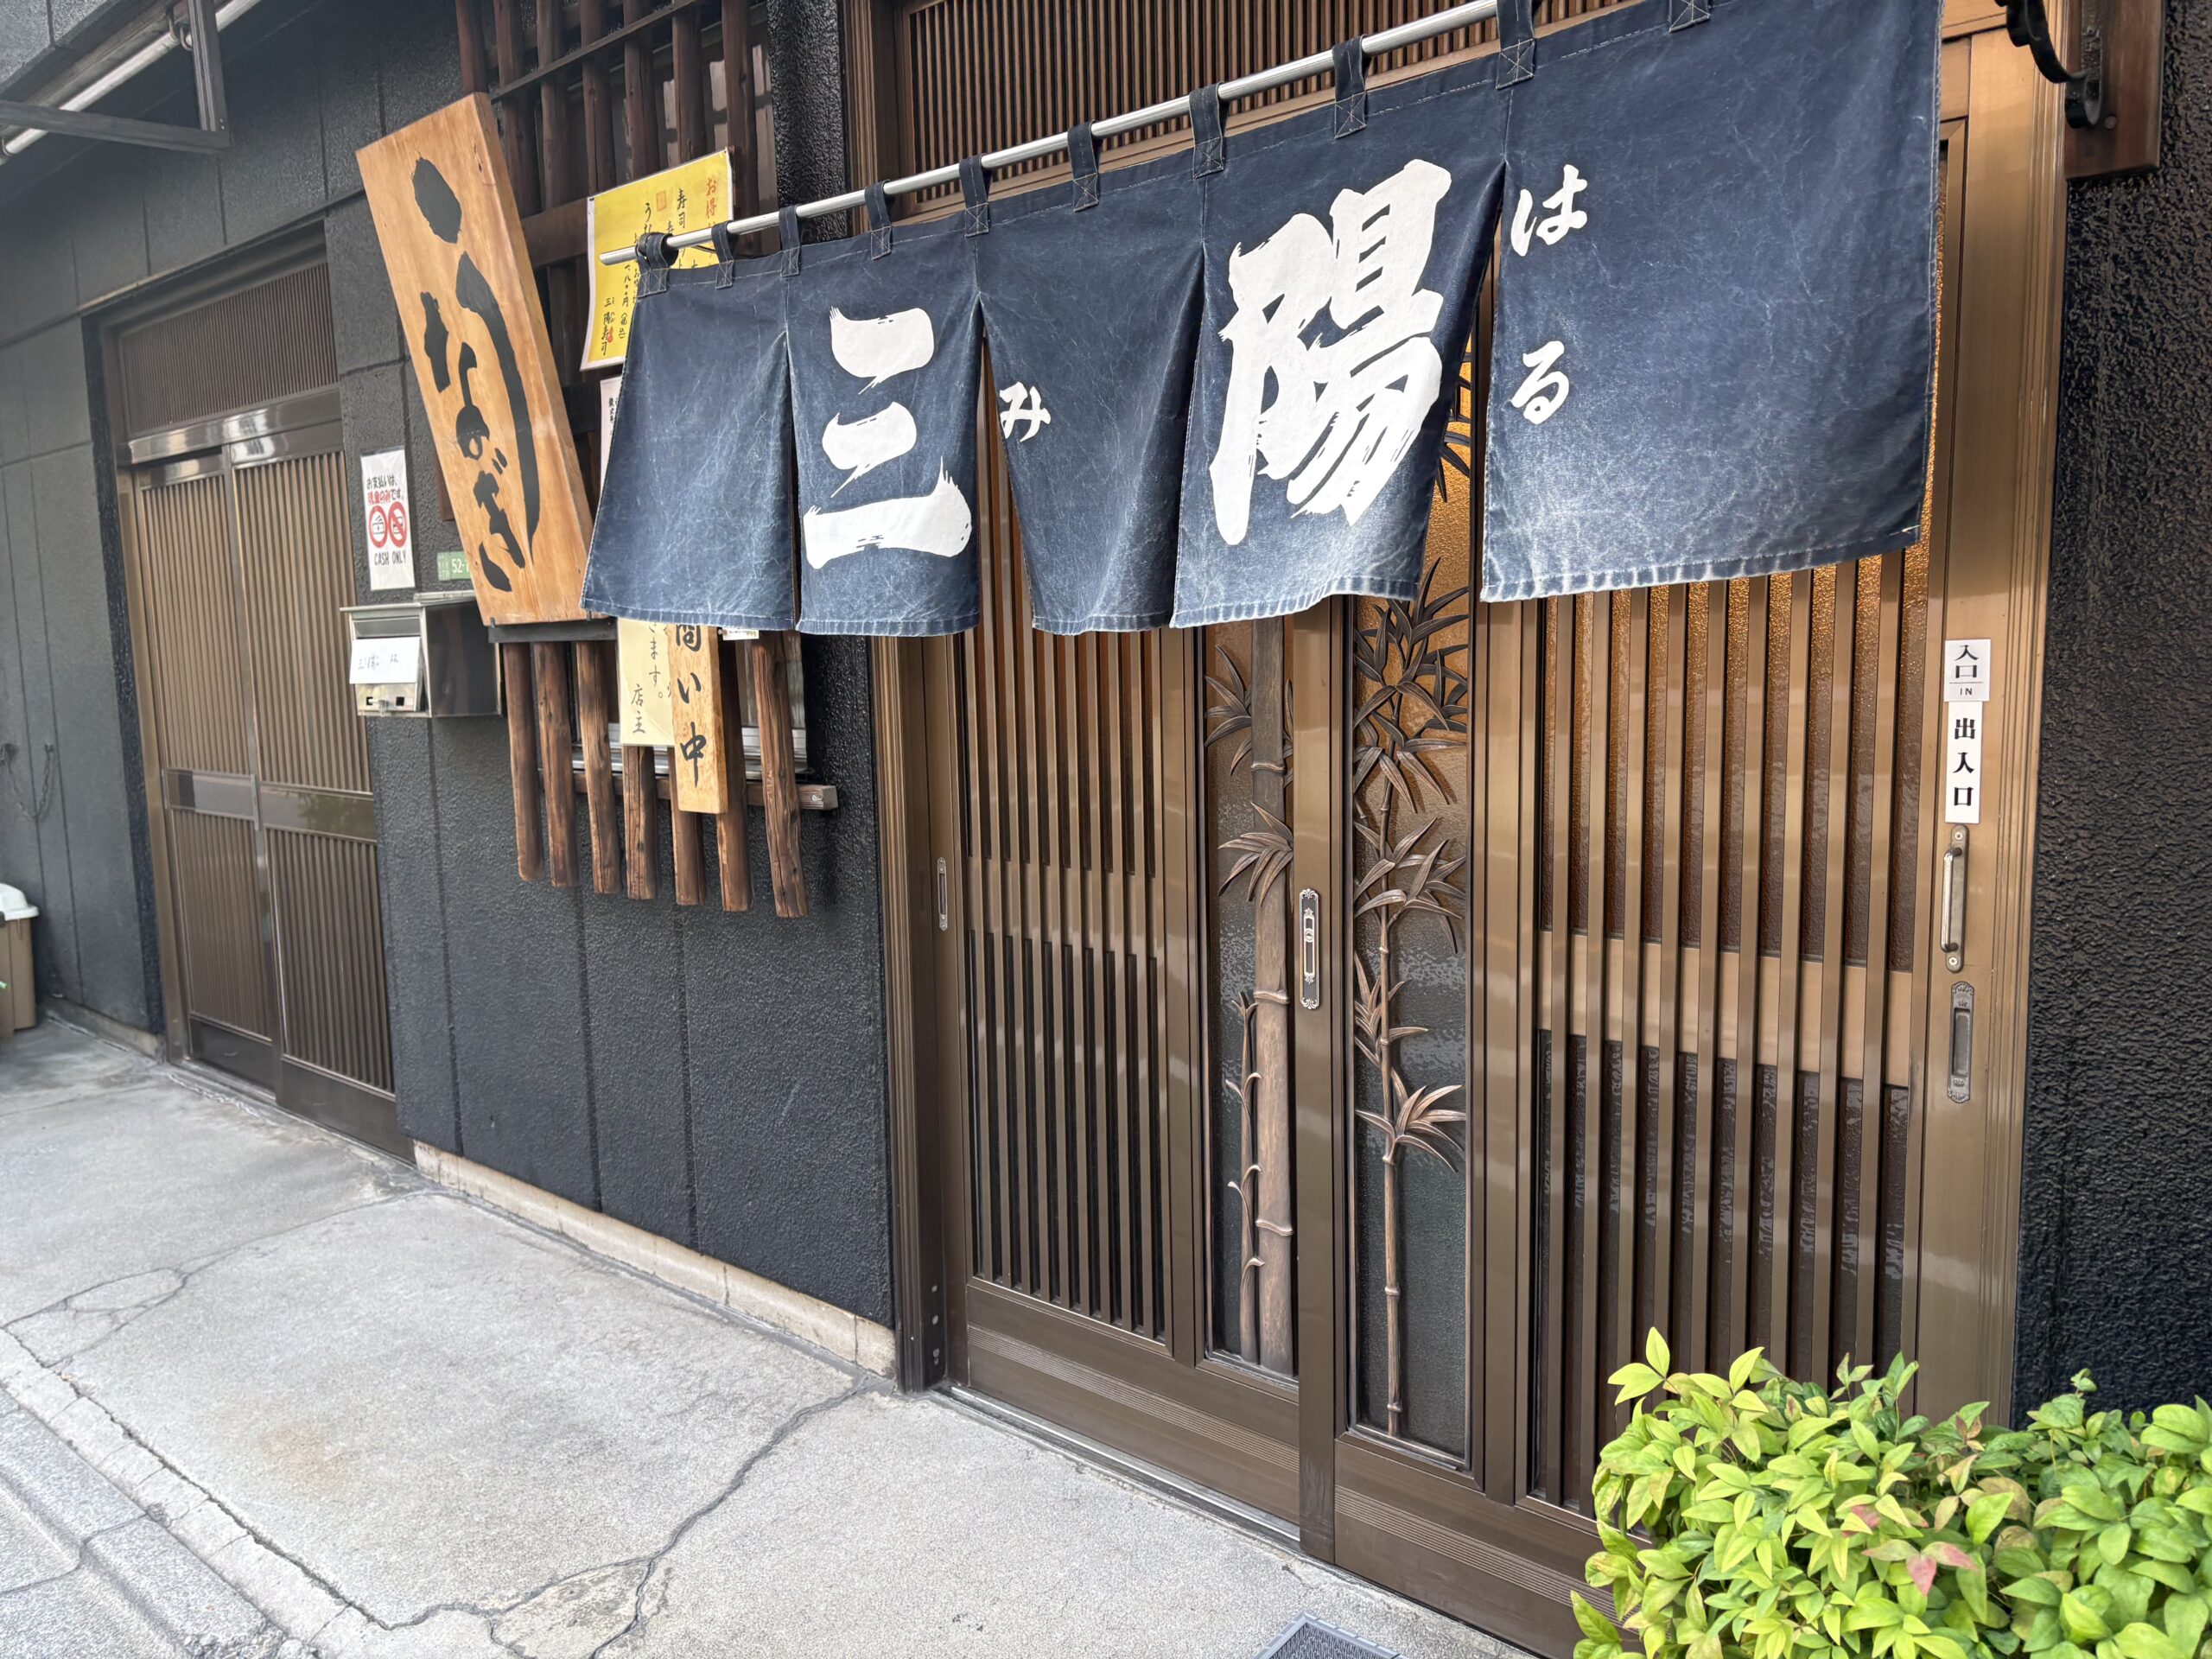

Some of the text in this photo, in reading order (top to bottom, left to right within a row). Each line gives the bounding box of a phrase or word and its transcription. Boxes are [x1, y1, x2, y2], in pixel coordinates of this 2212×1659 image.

[999, 381, 1052, 442] み
[373, 549, 407, 566] CASH ONLY
[1954, 645, 1980, 679] 入口
[631, 683, 645, 734] 店主
[1959, 687, 1974, 696] IN
[1953, 717, 1975, 806] 出入口
